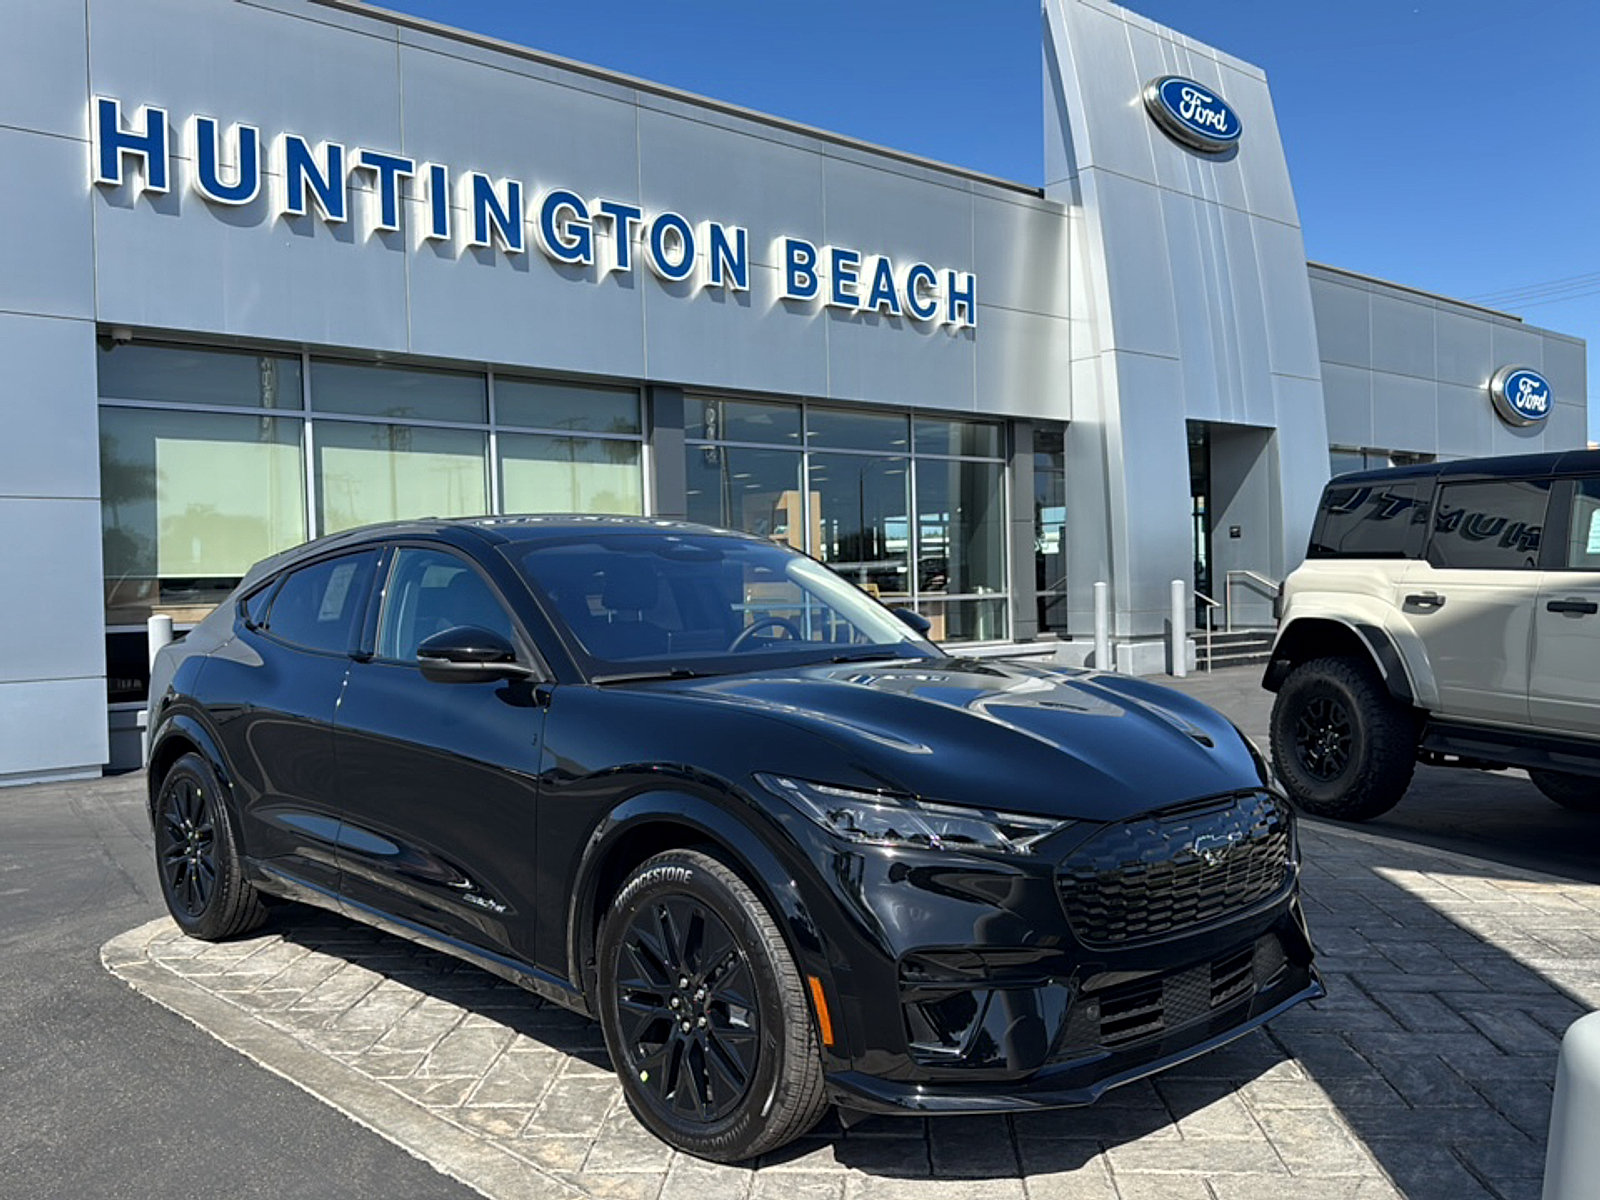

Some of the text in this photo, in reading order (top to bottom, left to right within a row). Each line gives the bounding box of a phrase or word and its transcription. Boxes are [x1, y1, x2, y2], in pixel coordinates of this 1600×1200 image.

[1179, 87, 1227, 132] Ford
[94, 96, 977, 327] HUNTINGTON BEACH
[1516, 377, 1548, 412] Ford
